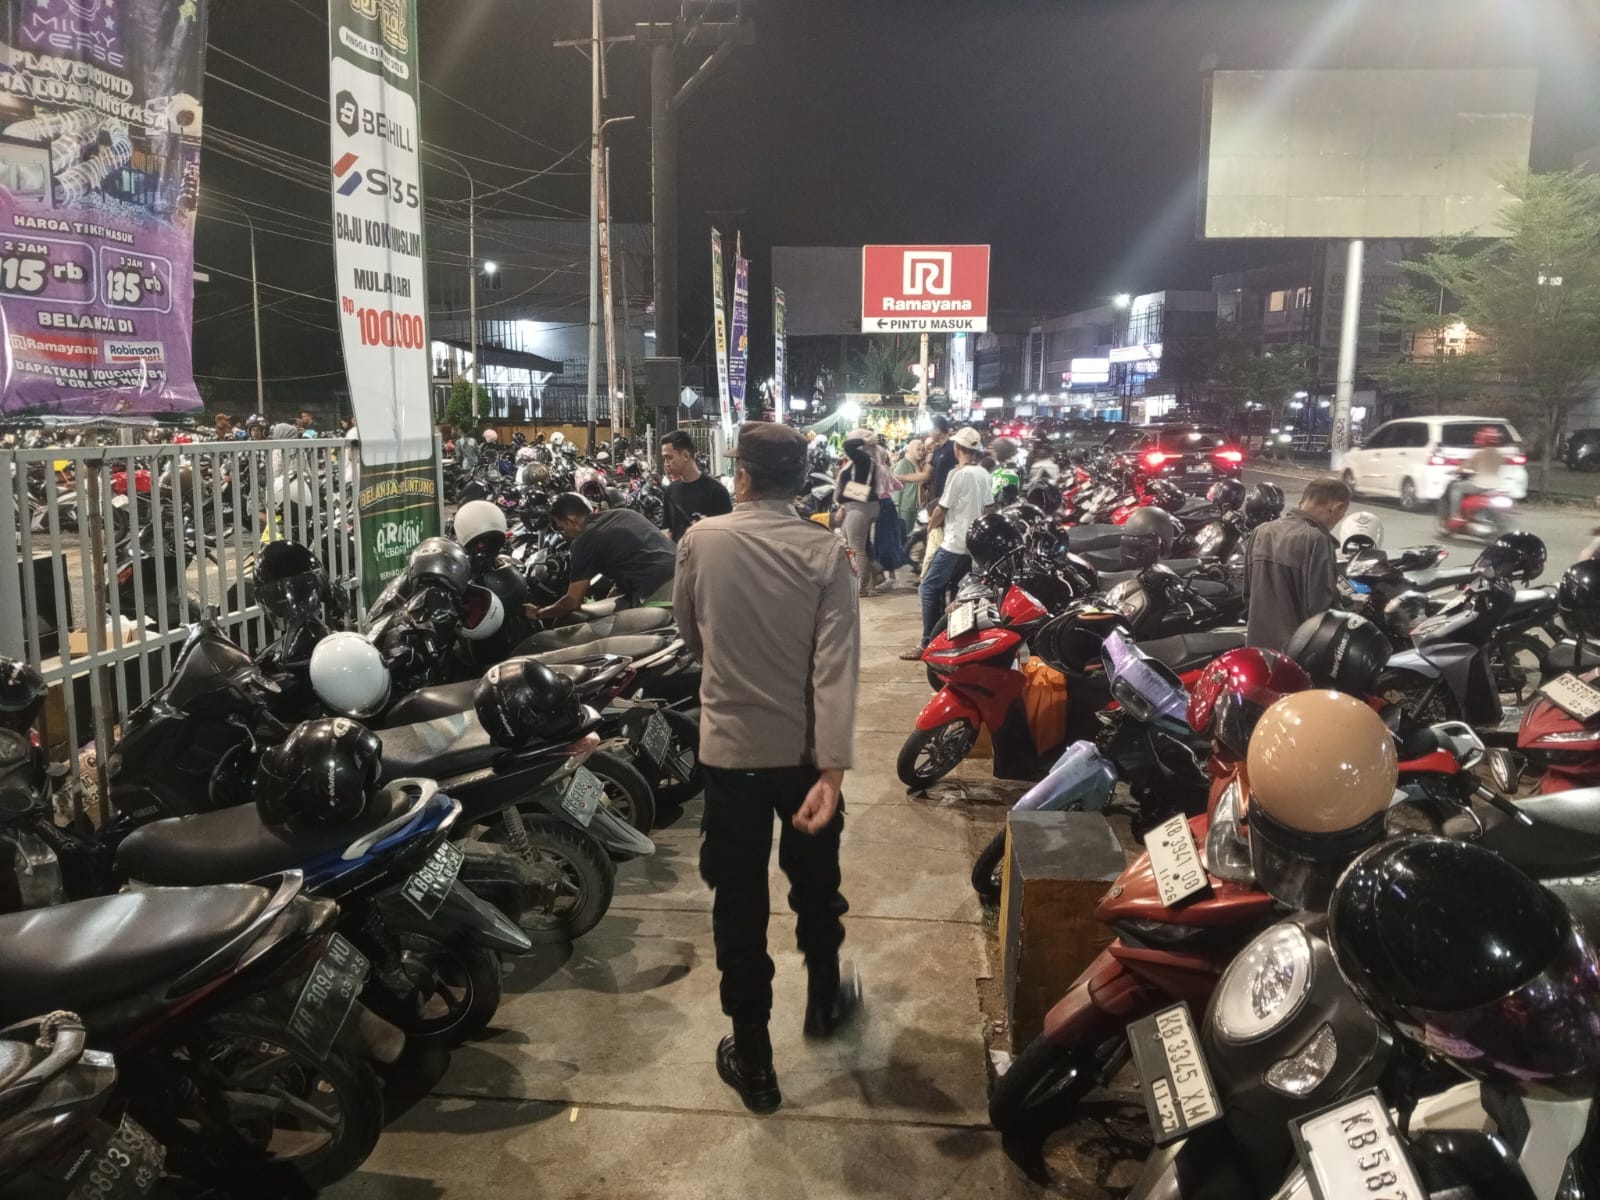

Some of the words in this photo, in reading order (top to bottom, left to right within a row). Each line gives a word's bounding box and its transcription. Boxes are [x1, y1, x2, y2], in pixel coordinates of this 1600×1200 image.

[23, 26, 124, 68] VERSE
[14, 215, 70, 233] HARGA
[105, 229, 134, 244] MASUK
[336, 211, 362, 244] BAJU
[365, 219, 391, 249] KOK
[5, 241, 14, 249] 2
[18, 242, 48, 254] JAM
[0, 257, 46, 292] 15
[53, 262, 84, 281] rb
[120, 256, 126, 266] 3
[127, 258, 143, 268] JAM
[107, 270, 140, 302] 135
[144, 275, 161, 292] rb
[354, 268, 392, 294] MULA
[342, 295, 354, 316] Rp
[882, 297, 972, 313] Ramayana
[38, 311, 115, 331] BELANJA
[118, 319, 134, 333] DI
[890, 319, 927, 329] PINTU
[930, 319, 973, 329] MASUK
[27, 337, 98, 356] Ramayana
[110, 344, 160, 355] Robinson
[15, 360, 88, 379] DAPATKAN
[361, 479, 399, 508] BELANJA
[1164, 818, 1183, 837] KB
[1170, 836, 1192, 868] 3941
[306, 964, 336, 1009] 3094
[1158, 1012, 1184, 1039] KB
[1167, 1039, 1199, 1084] 3345
[1181, 1088, 1210, 1122] XM
[1341, 1109, 1380, 1150] KB
